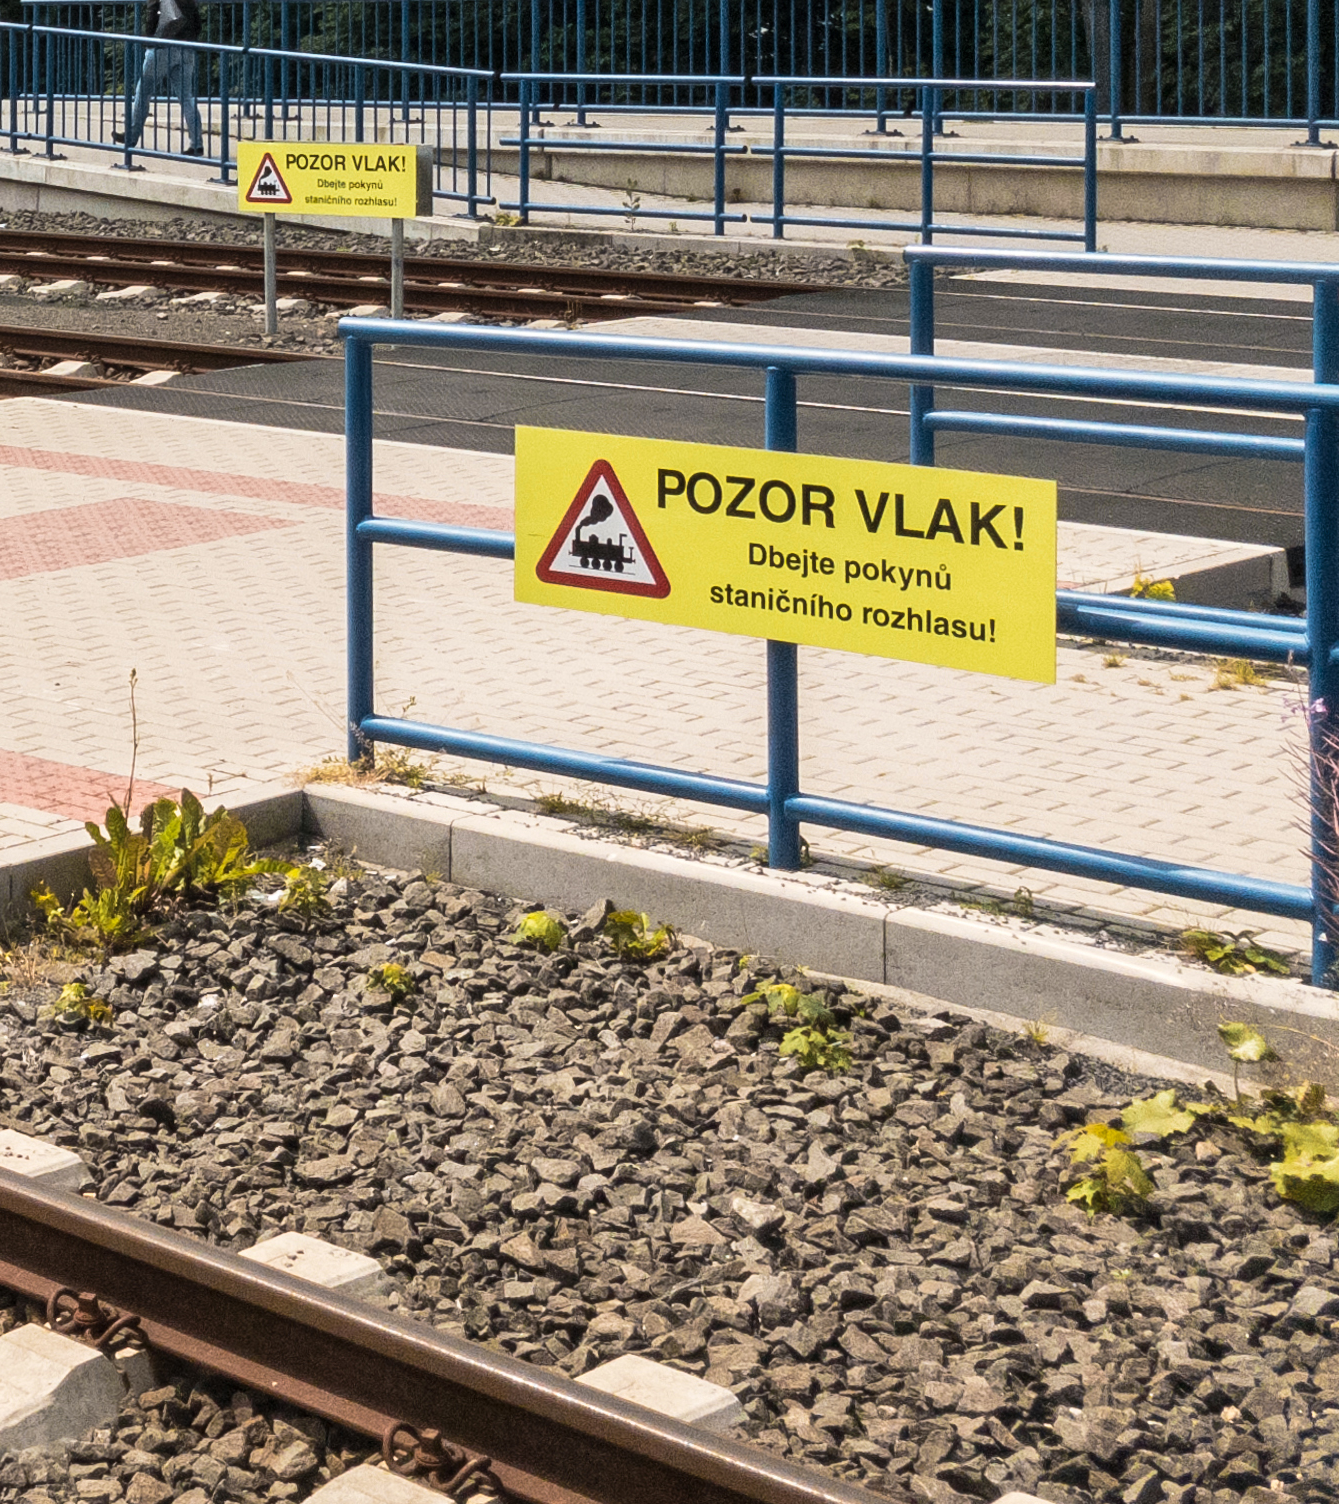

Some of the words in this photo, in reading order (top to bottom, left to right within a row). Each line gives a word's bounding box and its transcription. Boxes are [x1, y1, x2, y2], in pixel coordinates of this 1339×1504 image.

[286, 153, 346, 171] POZOR
[352, 155, 406, 172] VLAK!
[305, 194, 352, 206] staničního
[354, 196, 398, 207] rozhlasu!
[317, 178, 346, 190] Dbejte
[348, 180, 383, 192] pokynů
[656, 467, 837, 530] POZOR
[853, 488, 1026, 551] VLAK!
[748, 542, 836, 578] Dbejte
[843, 559, 953, 593] pokynů
[709, 582, 854, 623] staničního
[862, 604, 997, 643] rozhlasu!
